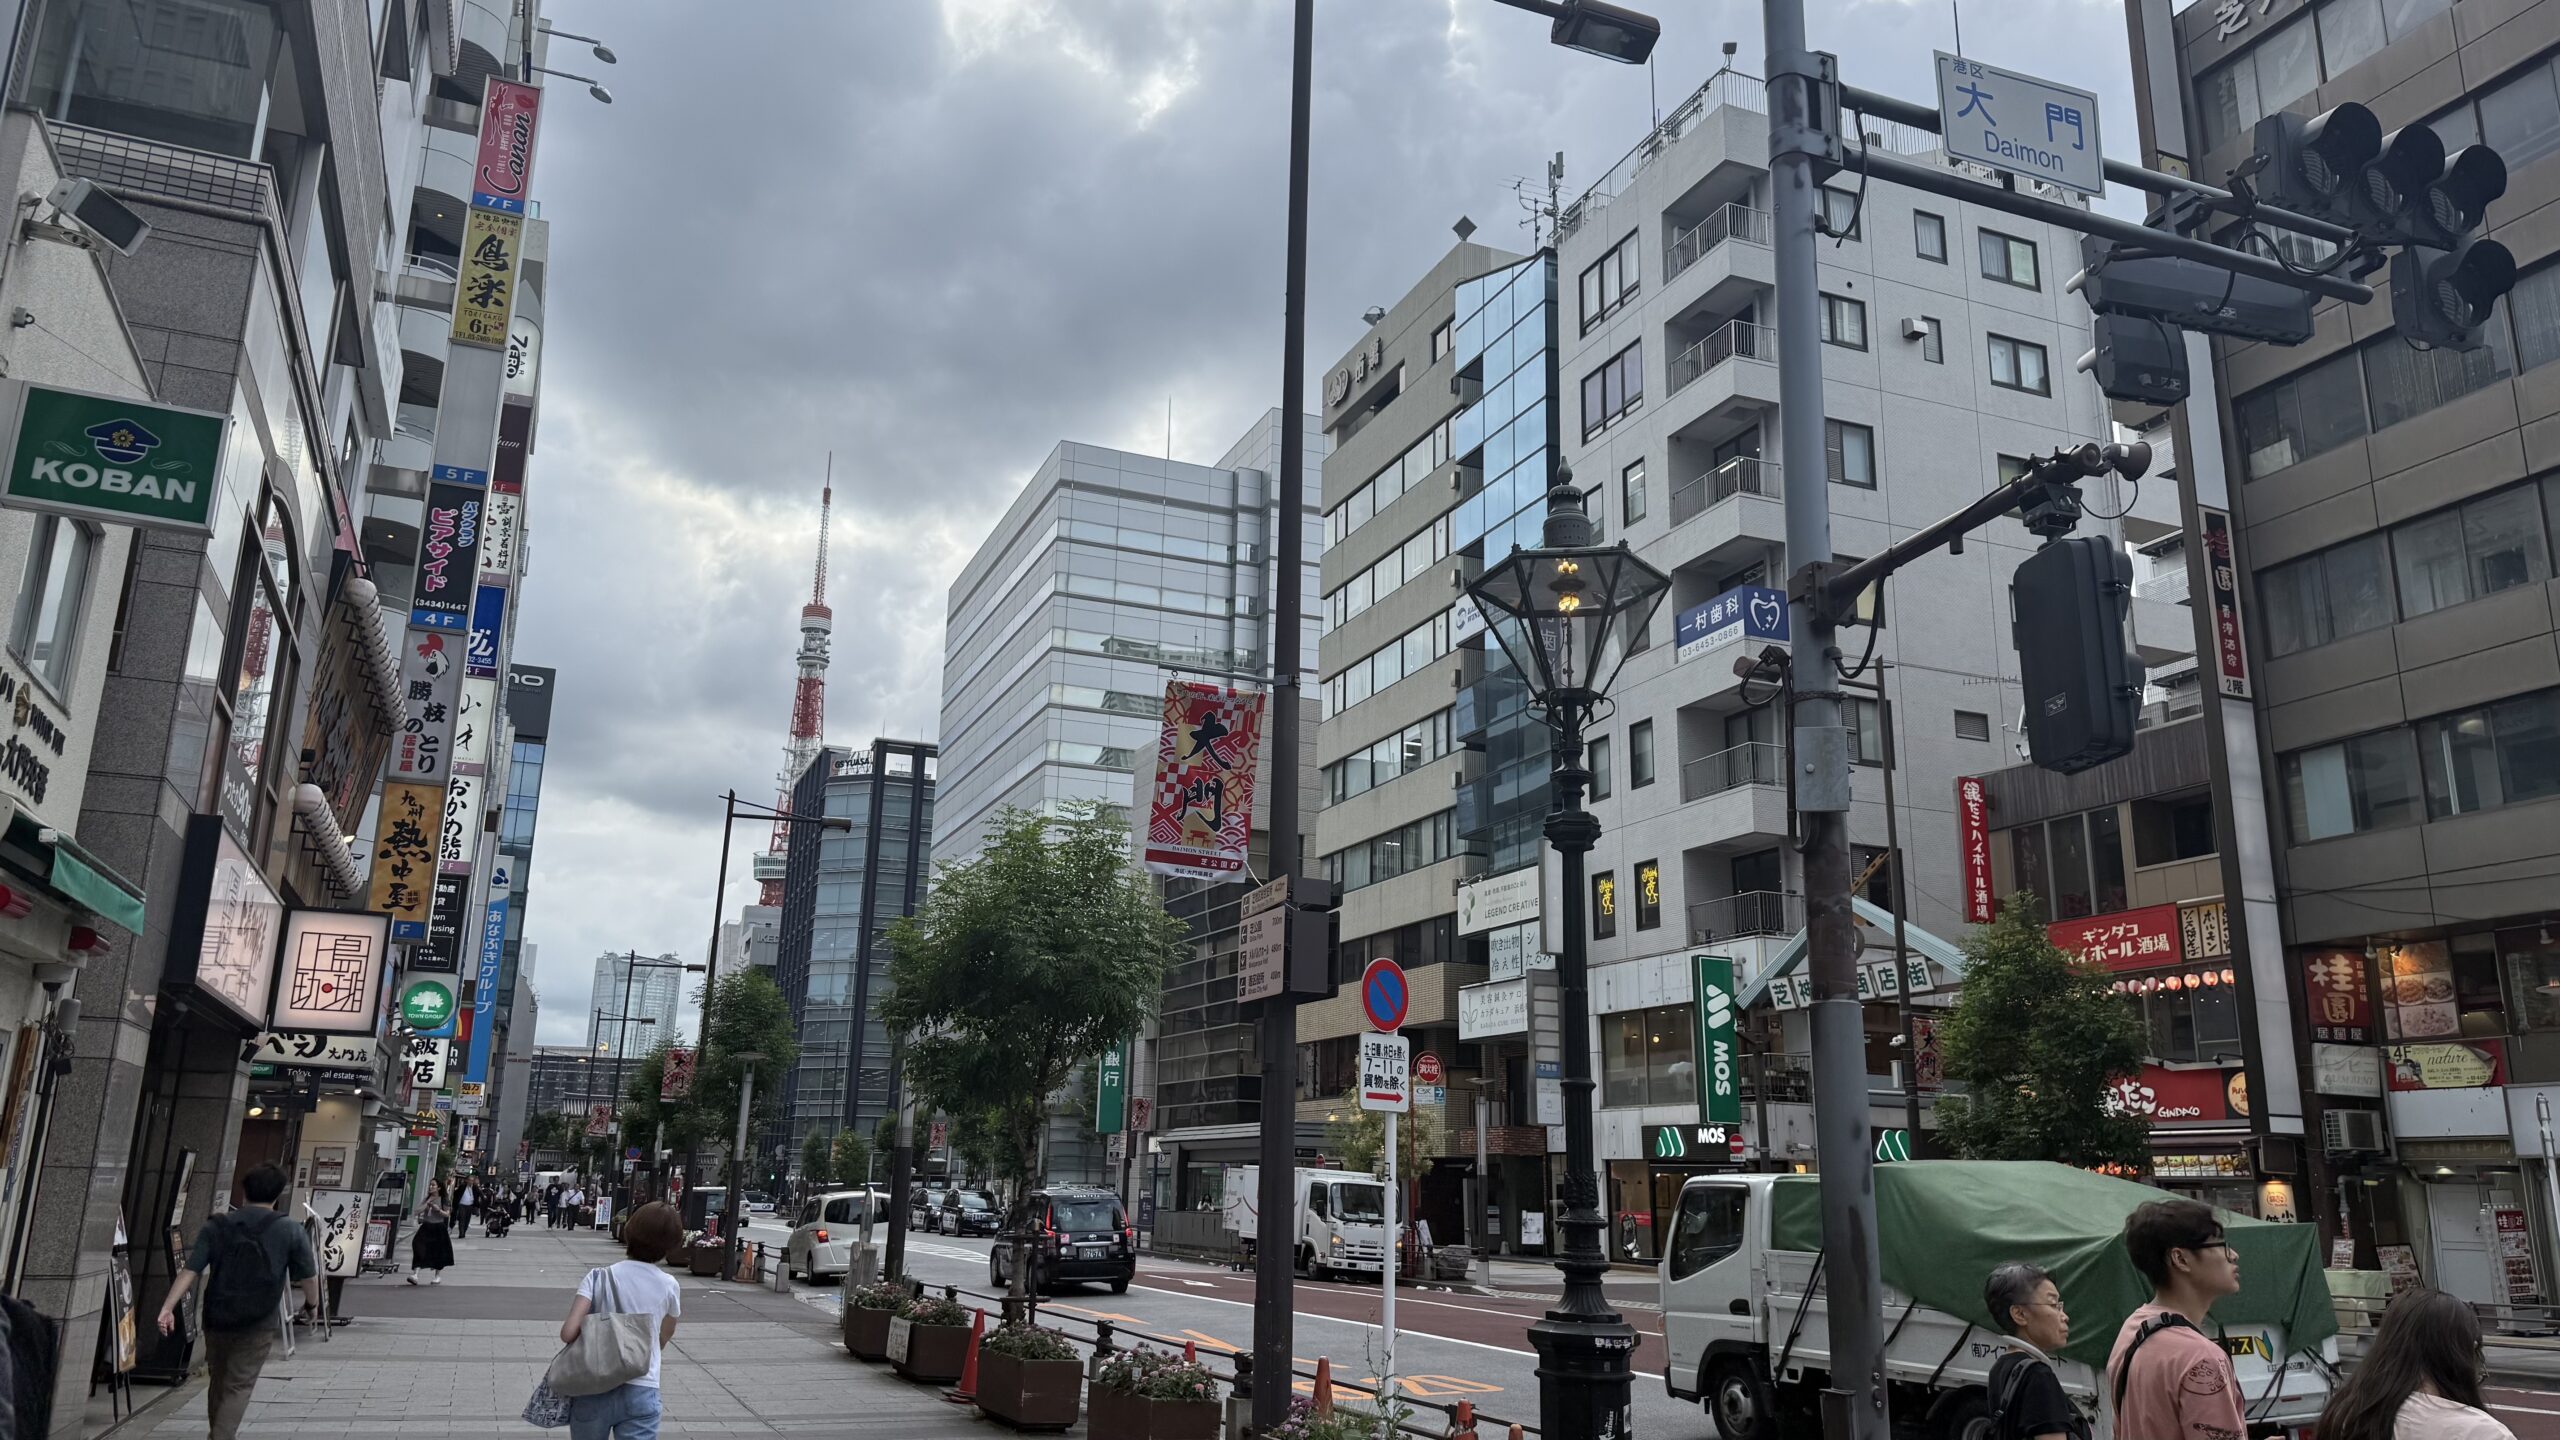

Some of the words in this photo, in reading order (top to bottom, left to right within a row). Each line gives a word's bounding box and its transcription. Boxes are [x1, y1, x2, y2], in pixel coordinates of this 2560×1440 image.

[1952, 58, 1985, 79] 港区
[1955, 81, 2084, 151] 大門
[1984, 129, 2064, 172] Daimon
[469, 318, 494, 335] 6F
[30, 456, 196, 504] KOBAN
[425, 614, 454, 626] 4F
[1680, 595, 1739, 632] 一村歯科
[1682, 625, 1739, 658] 03-6453-0866
[399, 735, 417, 772] 居酒屋
[845, 757, 871, 768] YUASA
[1177, 711, 1232, 832] 大門
[401, 790, 425, 820] 九州
[1172, 845, 1197, 854] DAIMON
[379, 819, 432, 912] 熱中屋
[1484, 905, 1507, 919] LEGEND
[1508, 897, 1539, 913] CREATIVE
[2082, 922, 2139, 943] ギンダコ
[2202, 909, 2218, 953] ホルモン
[1491, 933, 1520, 953] 吹き出物
[476, 910, 503, 1014] あなぶきグループ
[1491, 954, 1520, 973] 冷え性
[1772, 960, 1927, 1007] 芝神商店街
[2308, 953, 2355, 1024] 桂園
[1480, 990, 1527, 1005] 美容鍼灸サロ
[2317, 1027, 2362, 1041] 居酒屋
[2393, 1046, 2412, 1060] 4F
[334, 1071, 355, 1080] estate
[1104, 1050, 1120, 1087] 銀行
[1419, 1063, 1439, 1075] 消火栓
[1713, 1040, 1731, 1096] MOS
[1364, 1073, 1406, 1092] 貨物を除く
[2158, 1106, 2200, 1118] GINDACO
[1698, 1127, 1726, 1144] MOS
